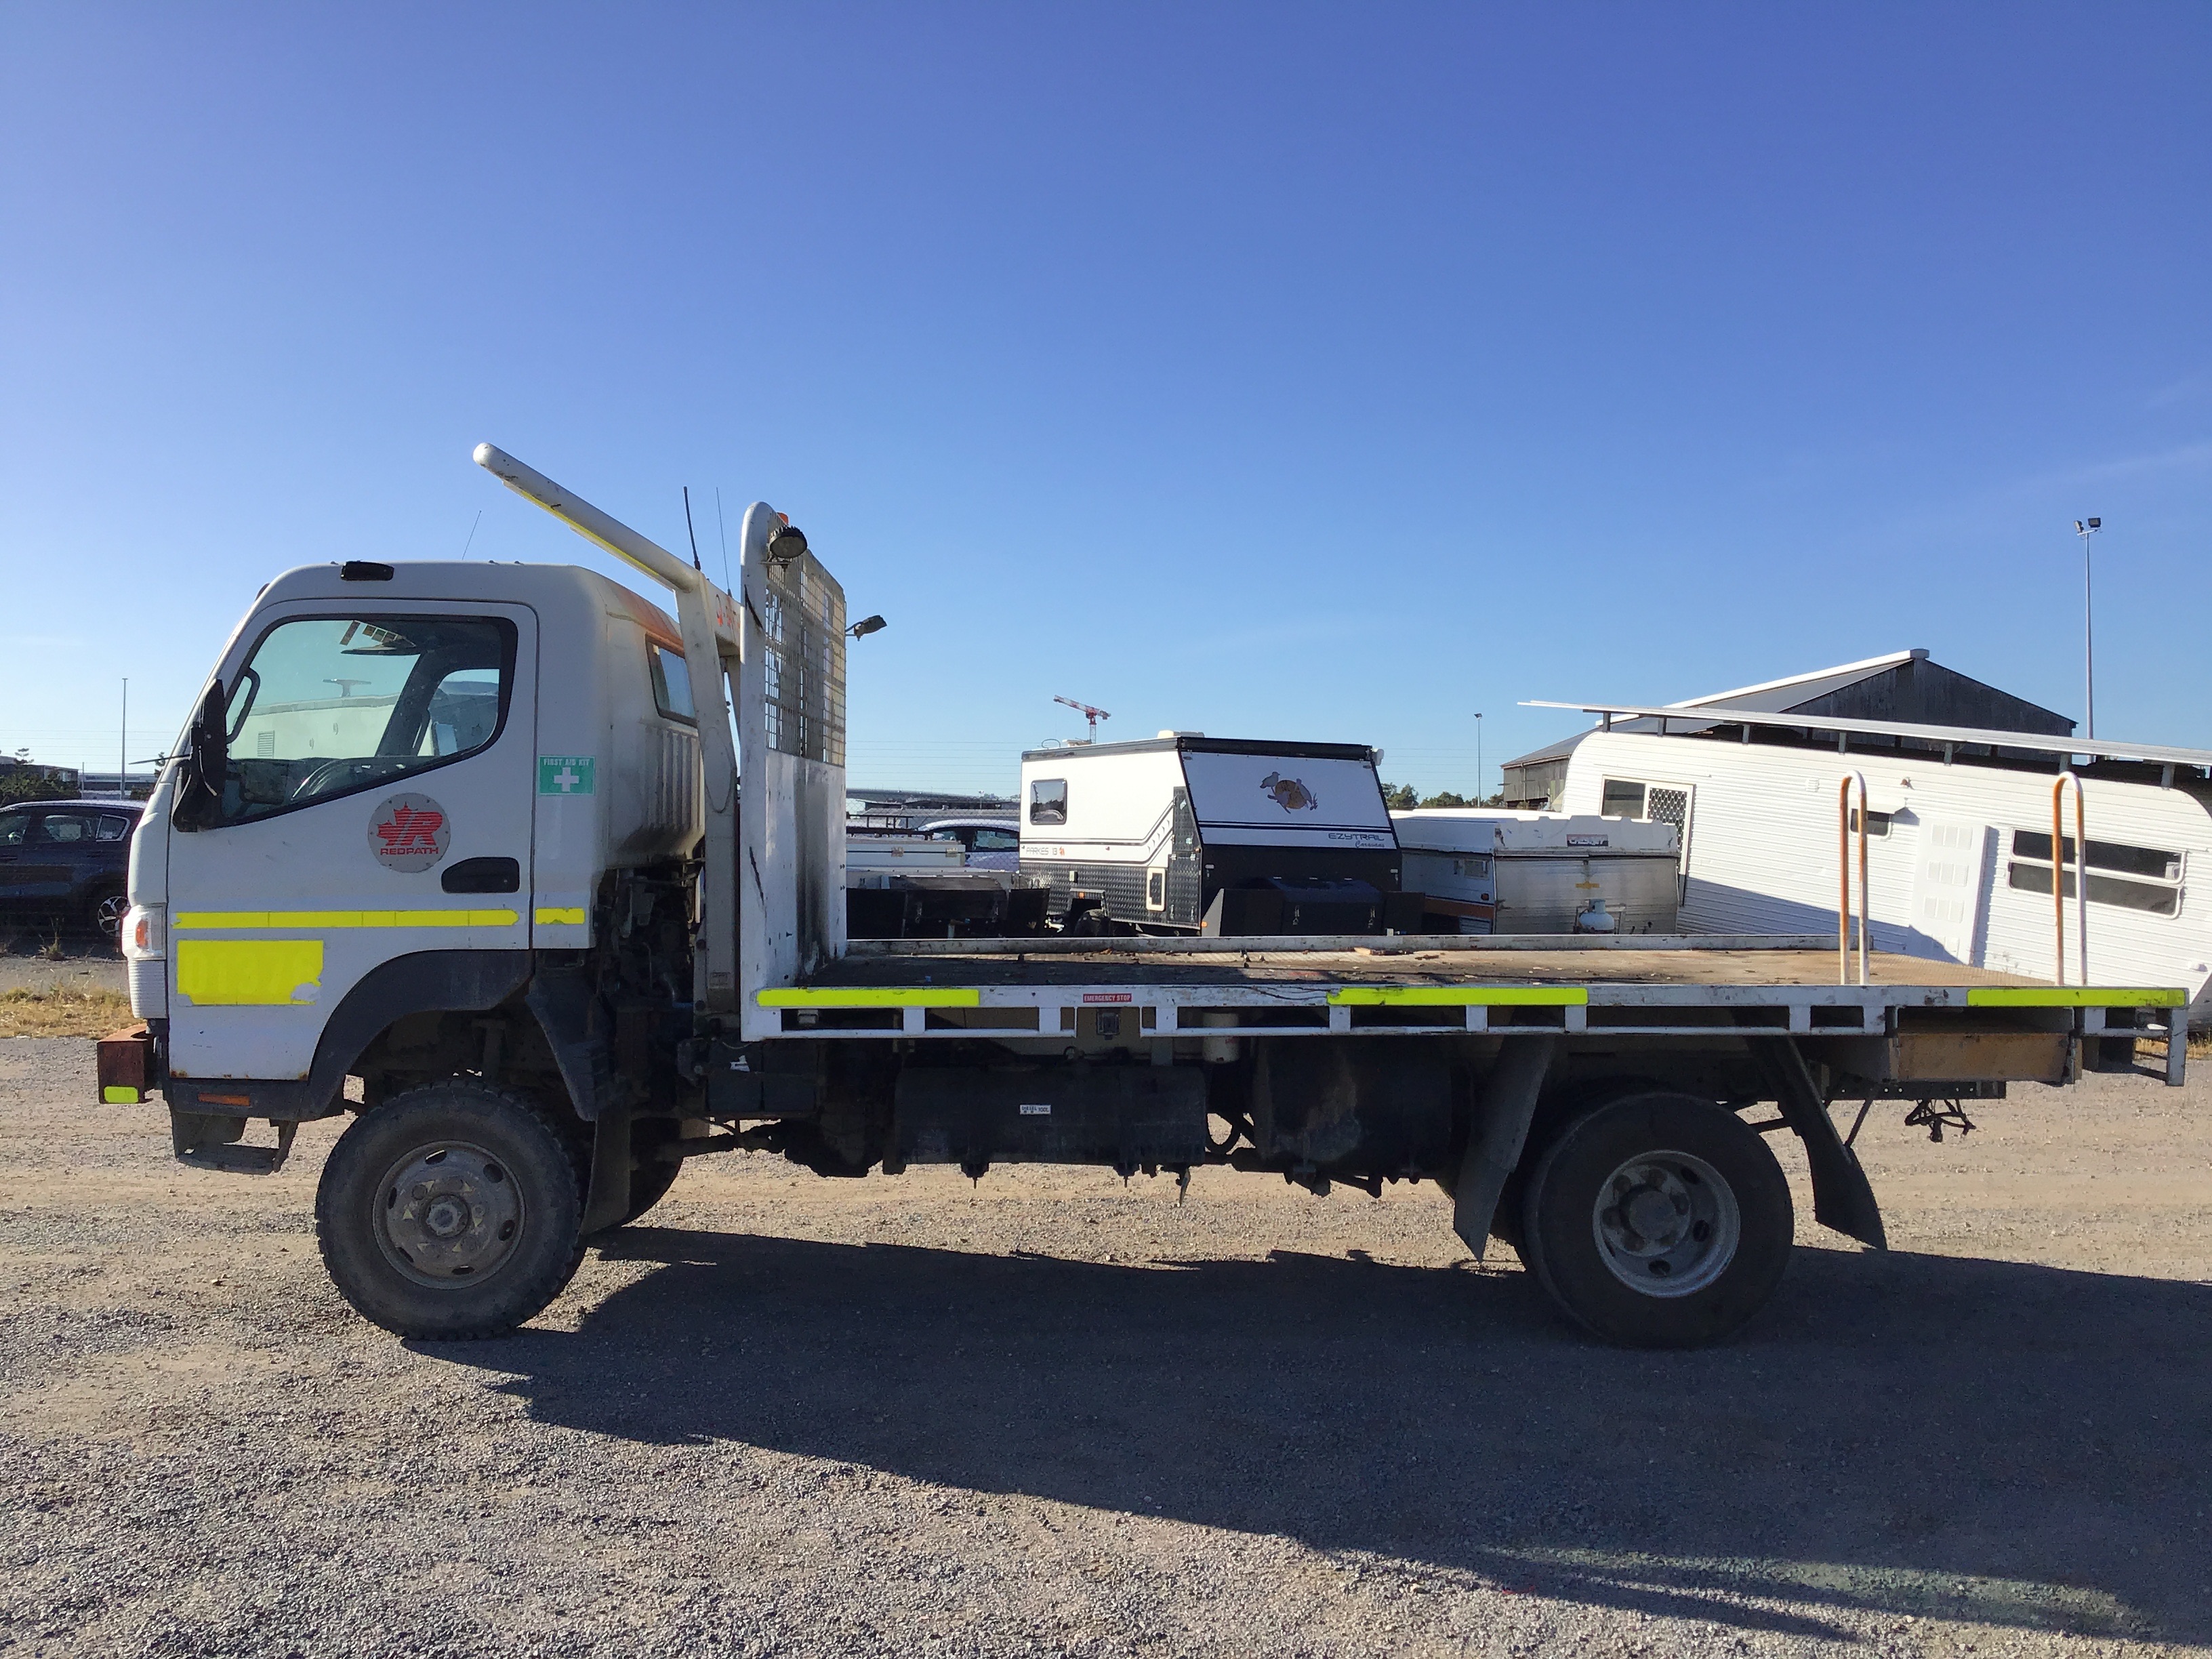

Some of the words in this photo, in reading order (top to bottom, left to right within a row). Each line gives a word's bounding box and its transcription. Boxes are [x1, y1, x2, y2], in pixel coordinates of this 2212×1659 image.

[1328, 833, 1385, 841] EZYTRAIL
[380, 847, 439, 855] REDPATH
[1026, 847, 1049, 855] PARKES
